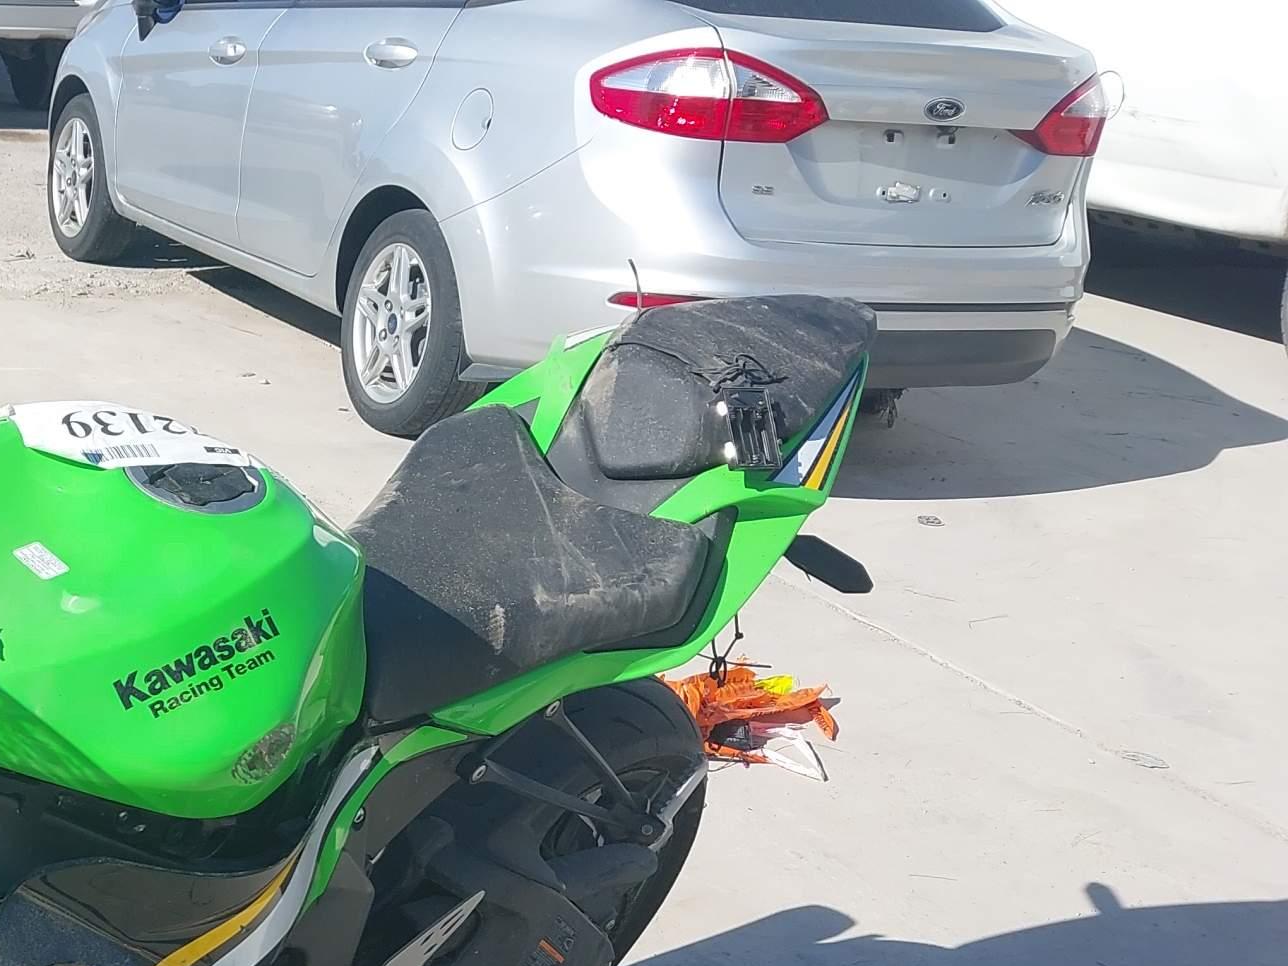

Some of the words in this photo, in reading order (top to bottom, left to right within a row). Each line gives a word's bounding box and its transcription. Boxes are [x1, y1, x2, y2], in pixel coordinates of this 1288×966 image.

[62, 410, 198, 439] 2139
[113, 608, 281, 711] Kawasaki
[148, 675, 224, 719] Racing
[221, 649, 276, 680] Team
